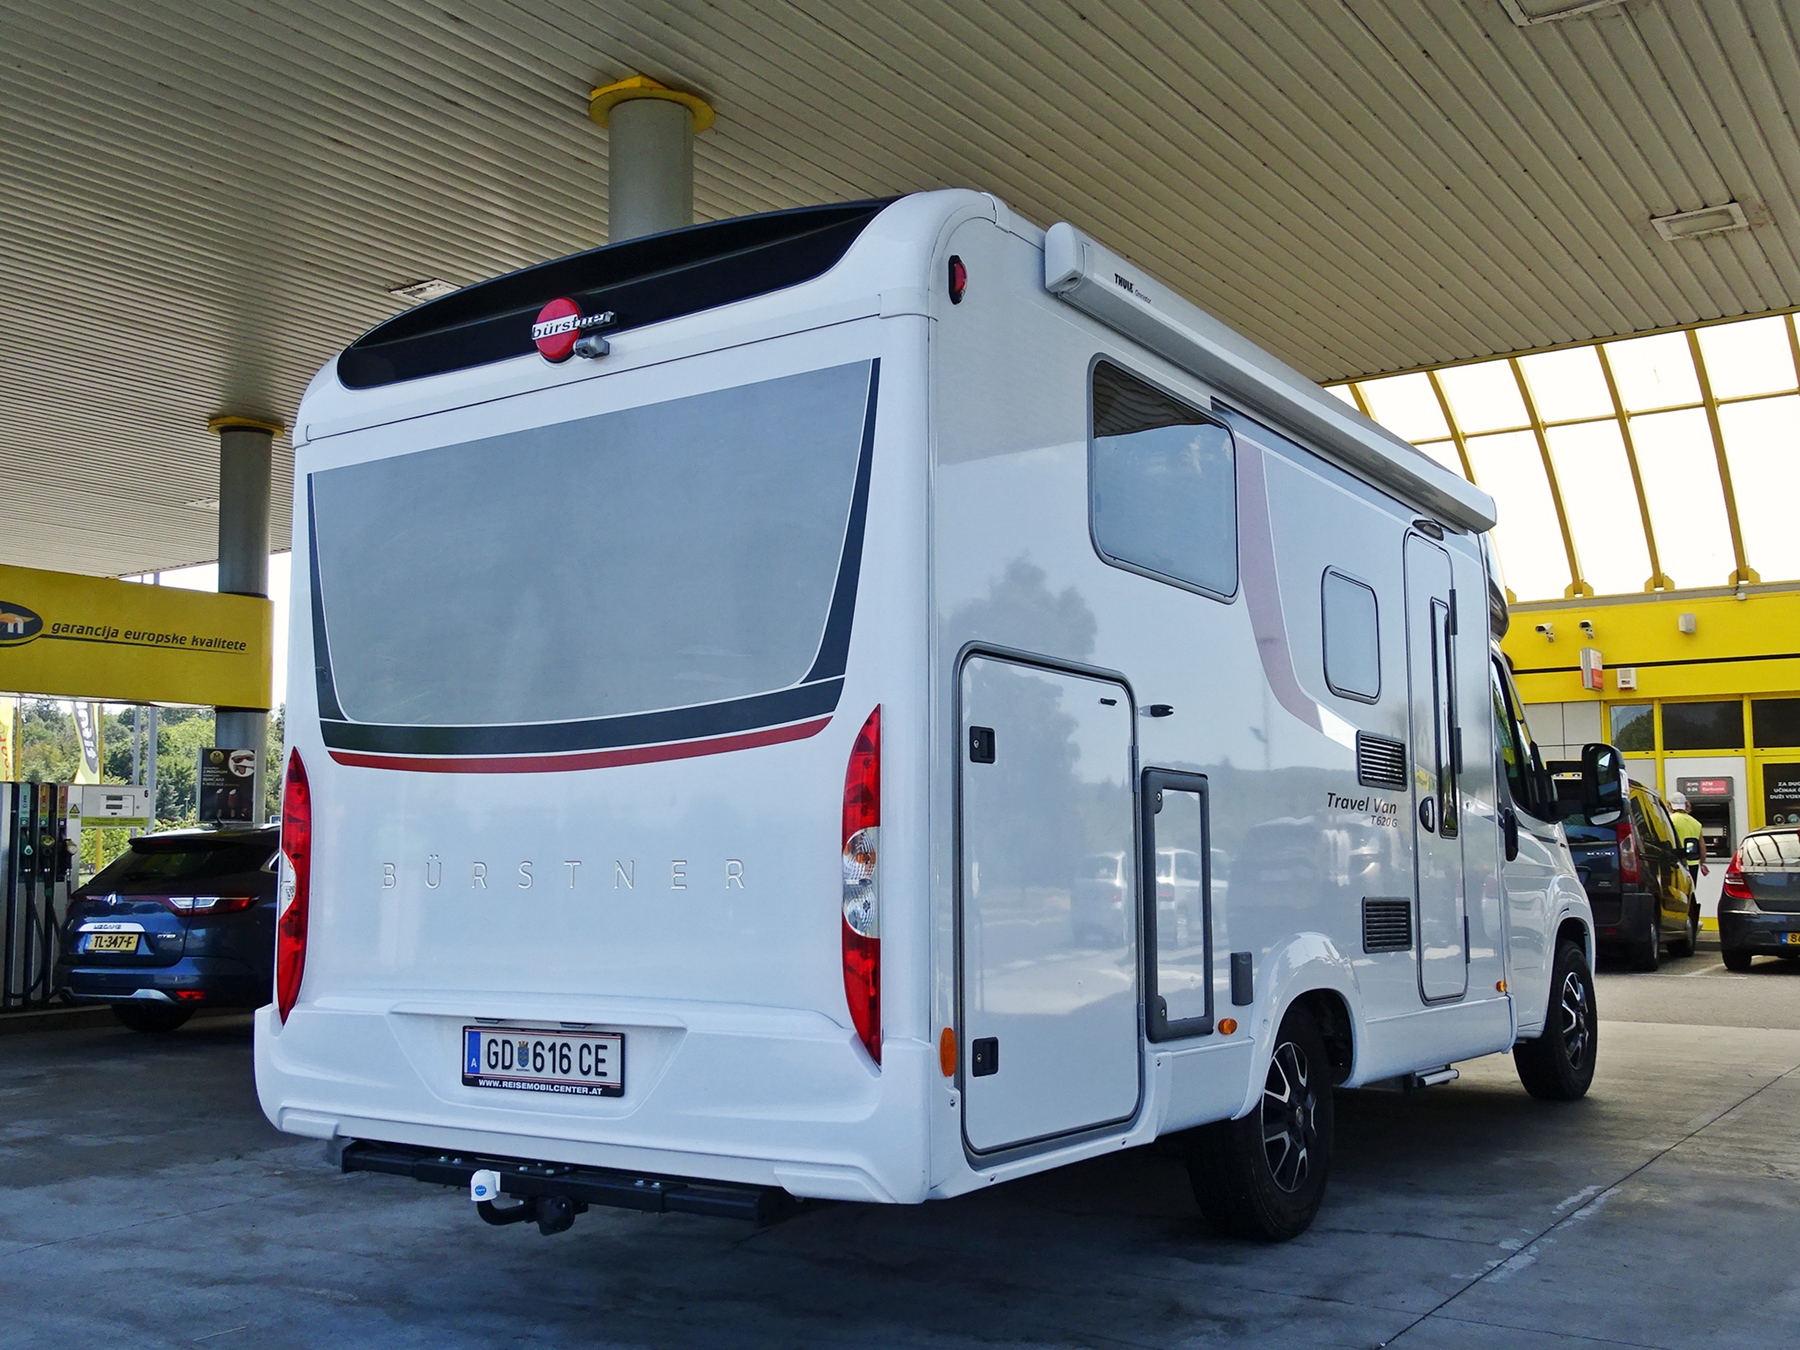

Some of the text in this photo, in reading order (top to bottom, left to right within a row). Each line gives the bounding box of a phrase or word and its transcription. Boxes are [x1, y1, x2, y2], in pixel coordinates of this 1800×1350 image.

[1114, 272, 1134, 293] THULE
[531, 310, 615, 340] bürstner
[51, 621, 247, 651] garancija europske kvalitete
[143, 789, 149, 798] 6
[1327, 792, 1397, 815] Travel Van
[381, 854, 745, 891] BÜRSTNER
[94, 935, 134, 948] TL-347-F
[470, 1057, 478, 1068] A
[487, 1038, 608, 1077] GD 616 CE
[478, 1078, 602, 1095] WWW.REISEMOBILCENTER.AT
